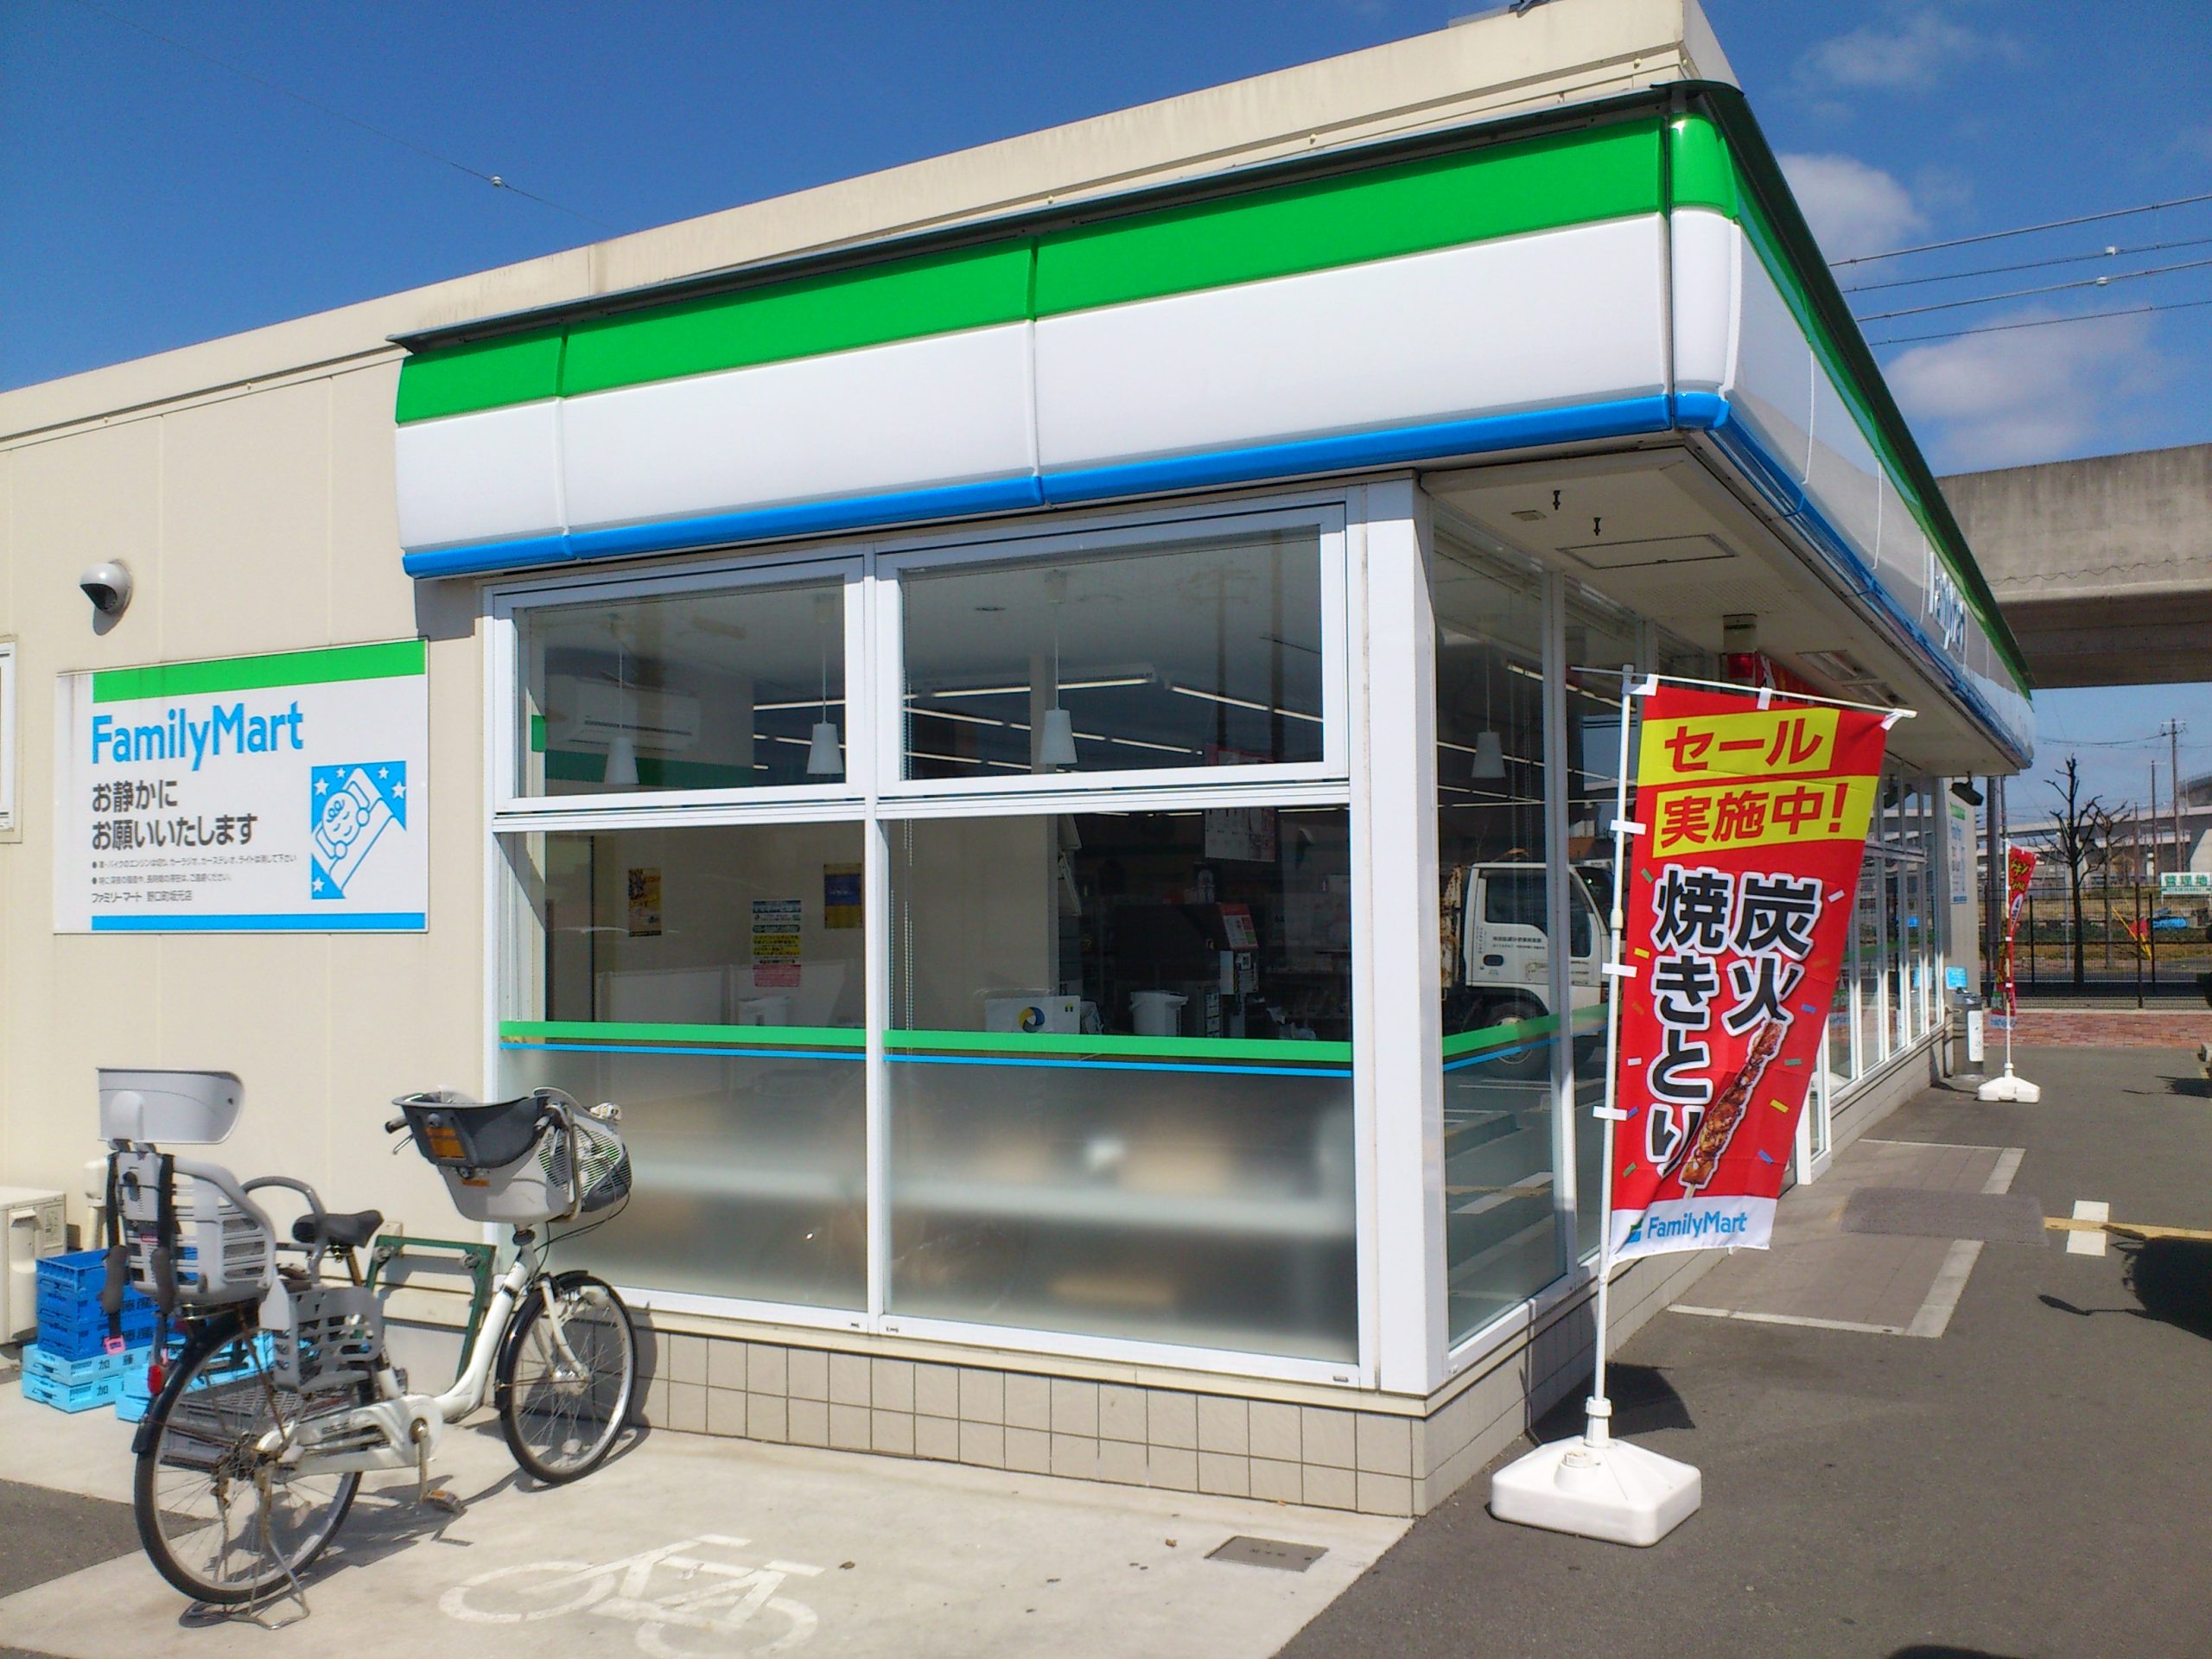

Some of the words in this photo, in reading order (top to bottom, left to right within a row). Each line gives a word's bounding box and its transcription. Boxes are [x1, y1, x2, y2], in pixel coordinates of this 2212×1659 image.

[92, 701, 303, 772] FamilyMart
[1664, 717, 1824, 772] セール
[92, 779, 178, 812] お静かに
[92, 813, 257, 851] お願いいたします
[91, 892, 143, 903] ファミリーマート
[1726, 876, 1820, 1037] 炭火
[1649, 868, 1729, 1175] 焼きとり
[1648, 1211, 1747, 1238] FamilyMart
